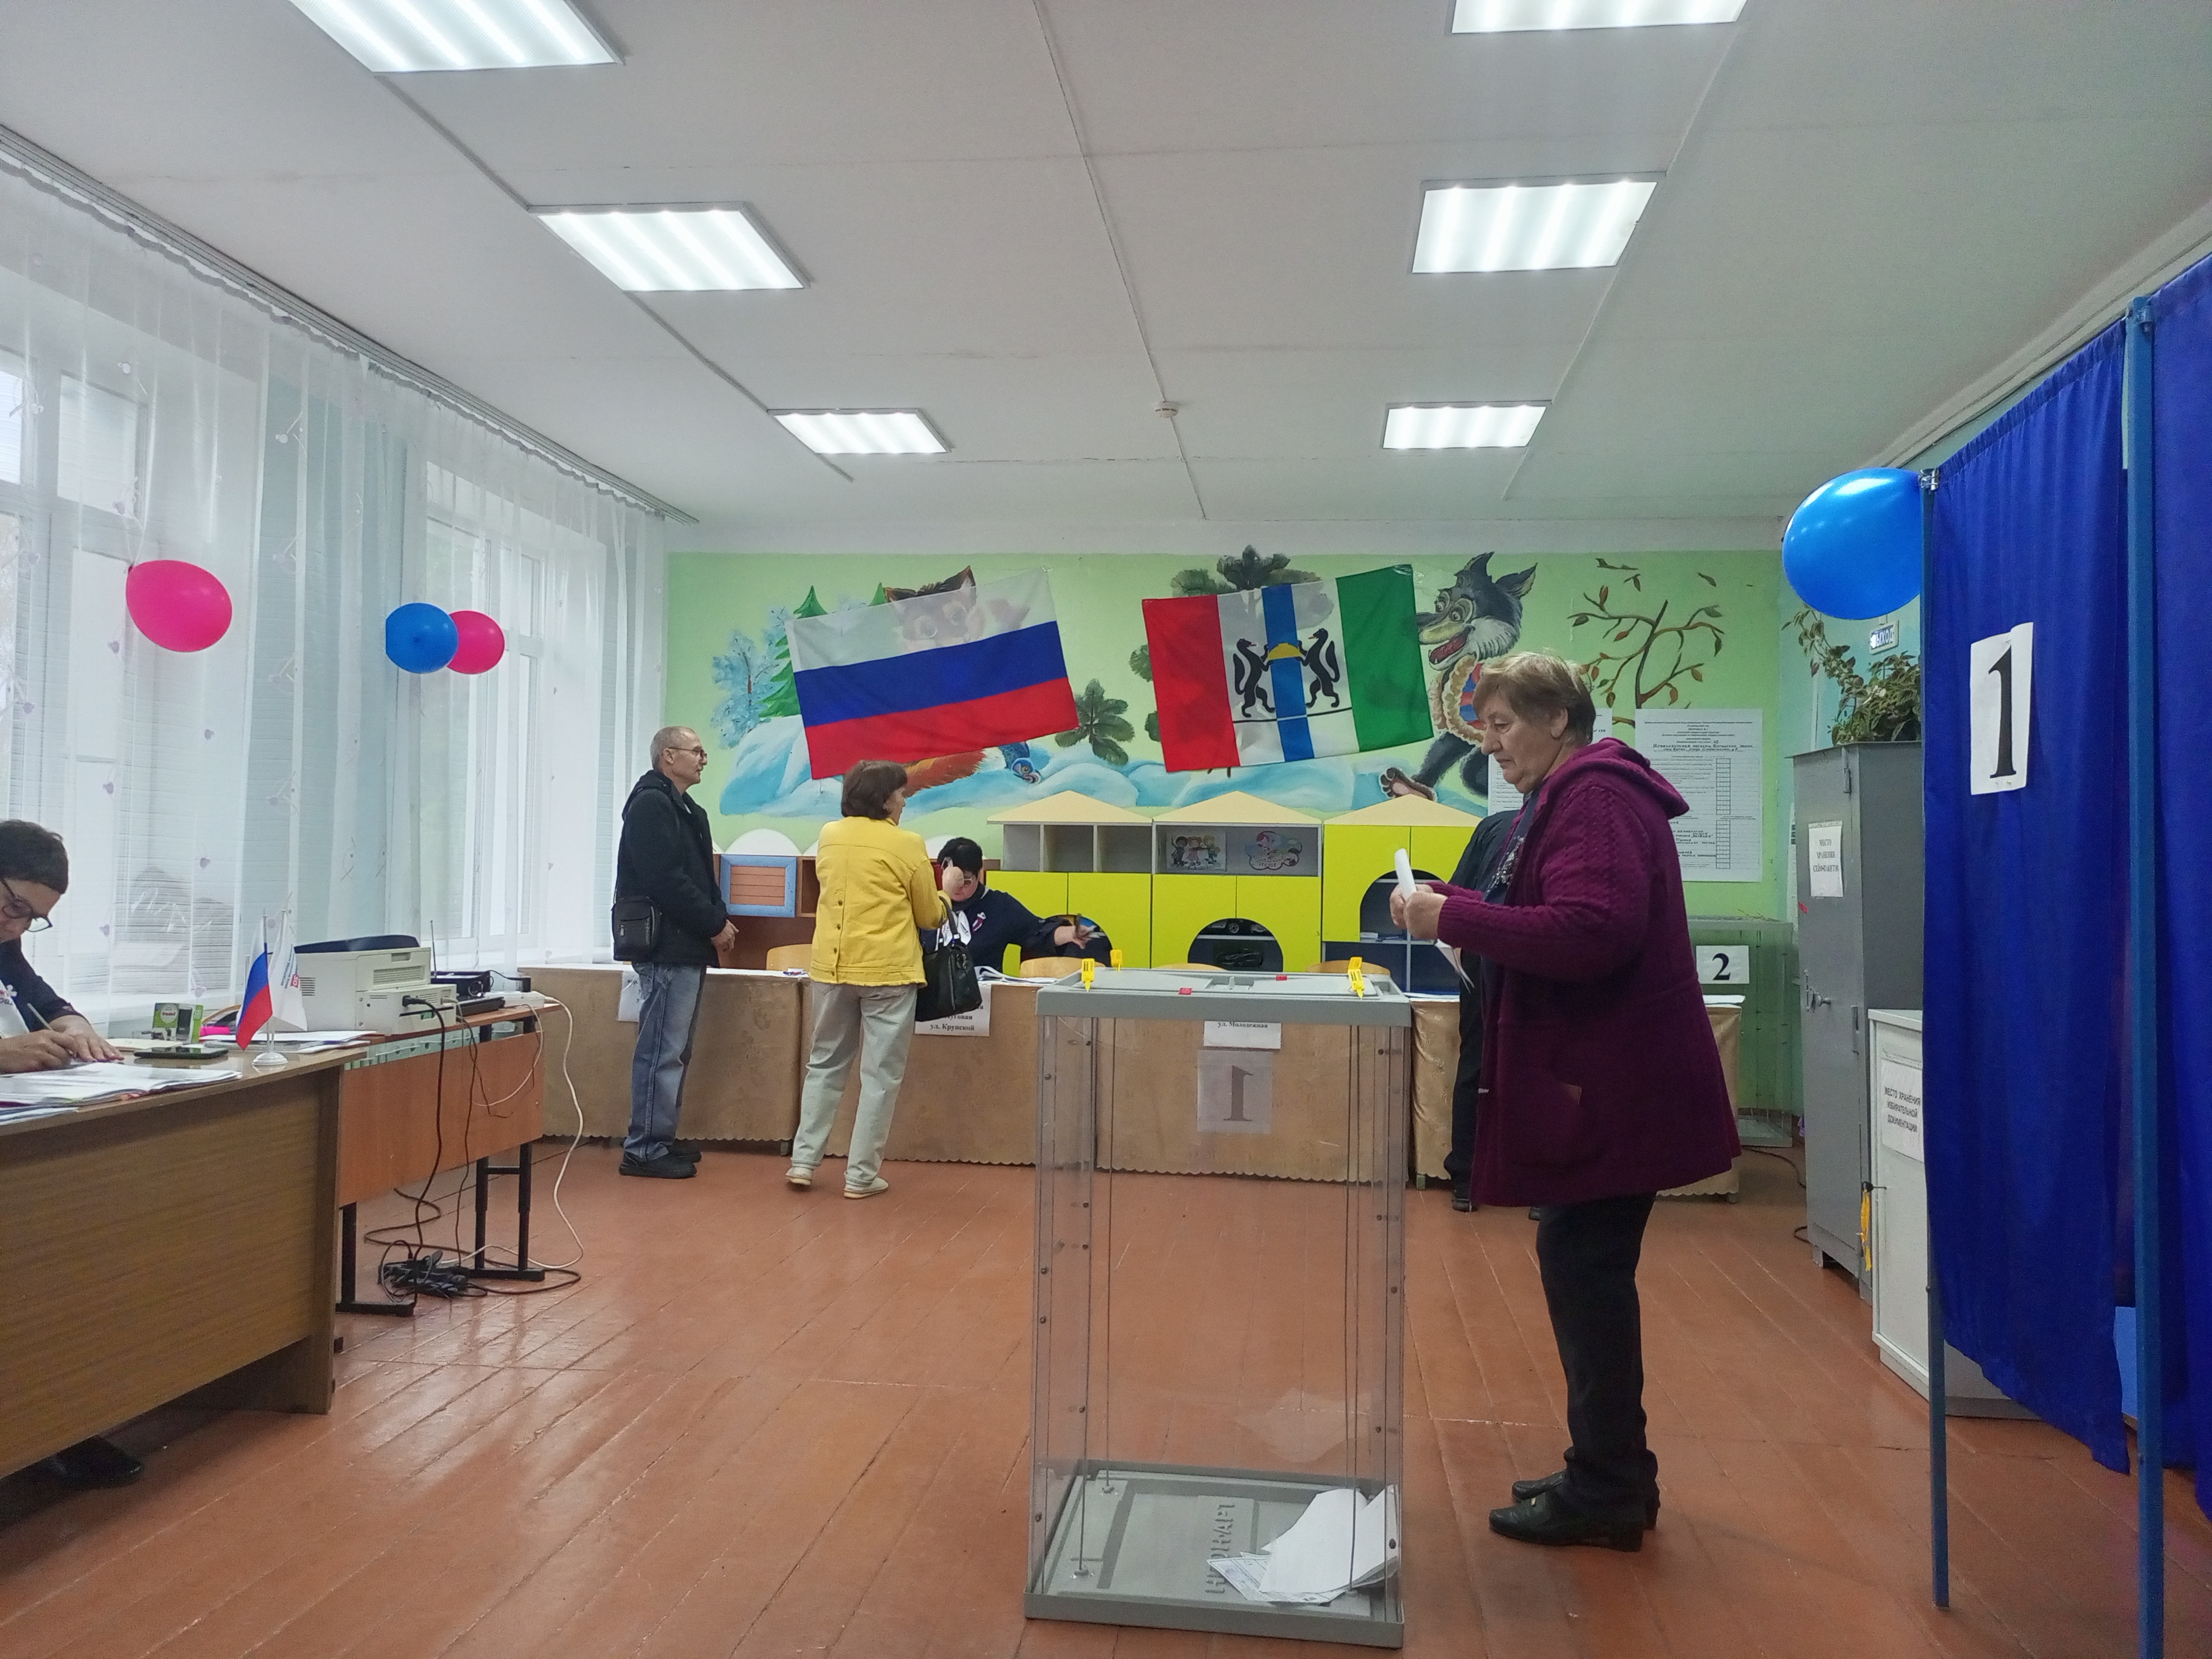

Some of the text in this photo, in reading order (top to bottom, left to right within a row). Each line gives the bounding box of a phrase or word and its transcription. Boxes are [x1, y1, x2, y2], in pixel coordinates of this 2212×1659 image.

[1988, 644, 2016, 779] 1
[1713, 953, 1731, 981] 2
[942, 1023, 974, 1031] Крупской
[1884, 1086, 1920, 1107] МЕСТО ХРАНЕНИЯ
